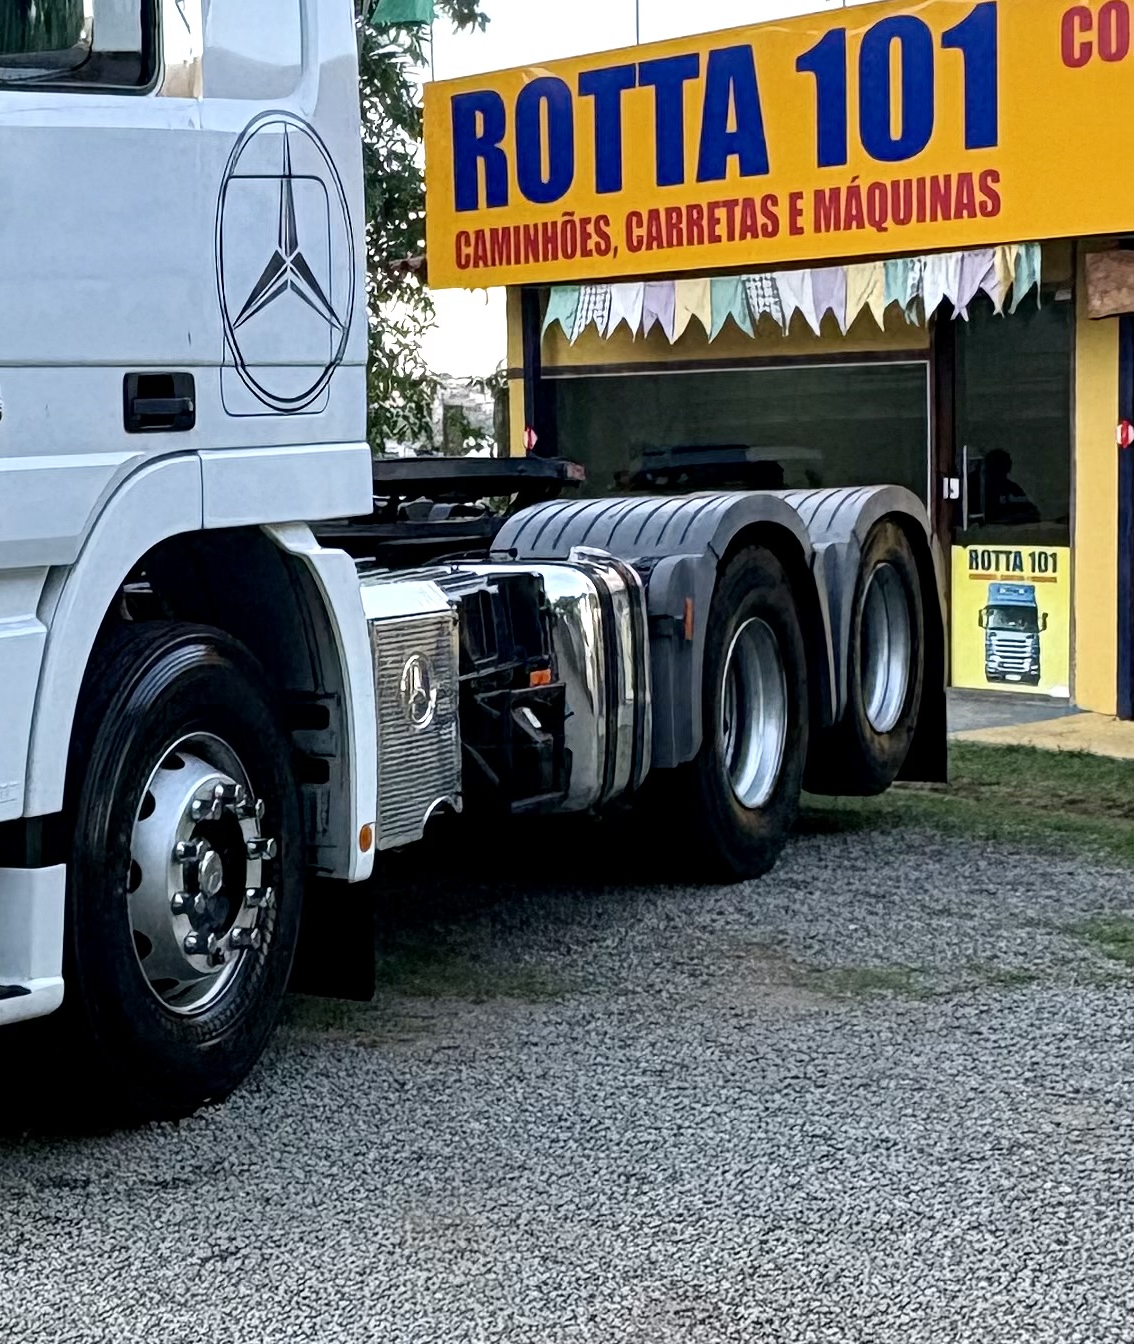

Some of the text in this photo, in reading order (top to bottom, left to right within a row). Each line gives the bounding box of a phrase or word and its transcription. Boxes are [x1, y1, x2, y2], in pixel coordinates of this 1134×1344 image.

[1060, 0, 1130, 68] CO
[450, 0, 998, 212] ROTTA 101
[454, 168, 1001, 271] CAMINHÕES, CARRETAS E MÁQUINAS
[968, 549, 1058, 573] ROTTA 101
